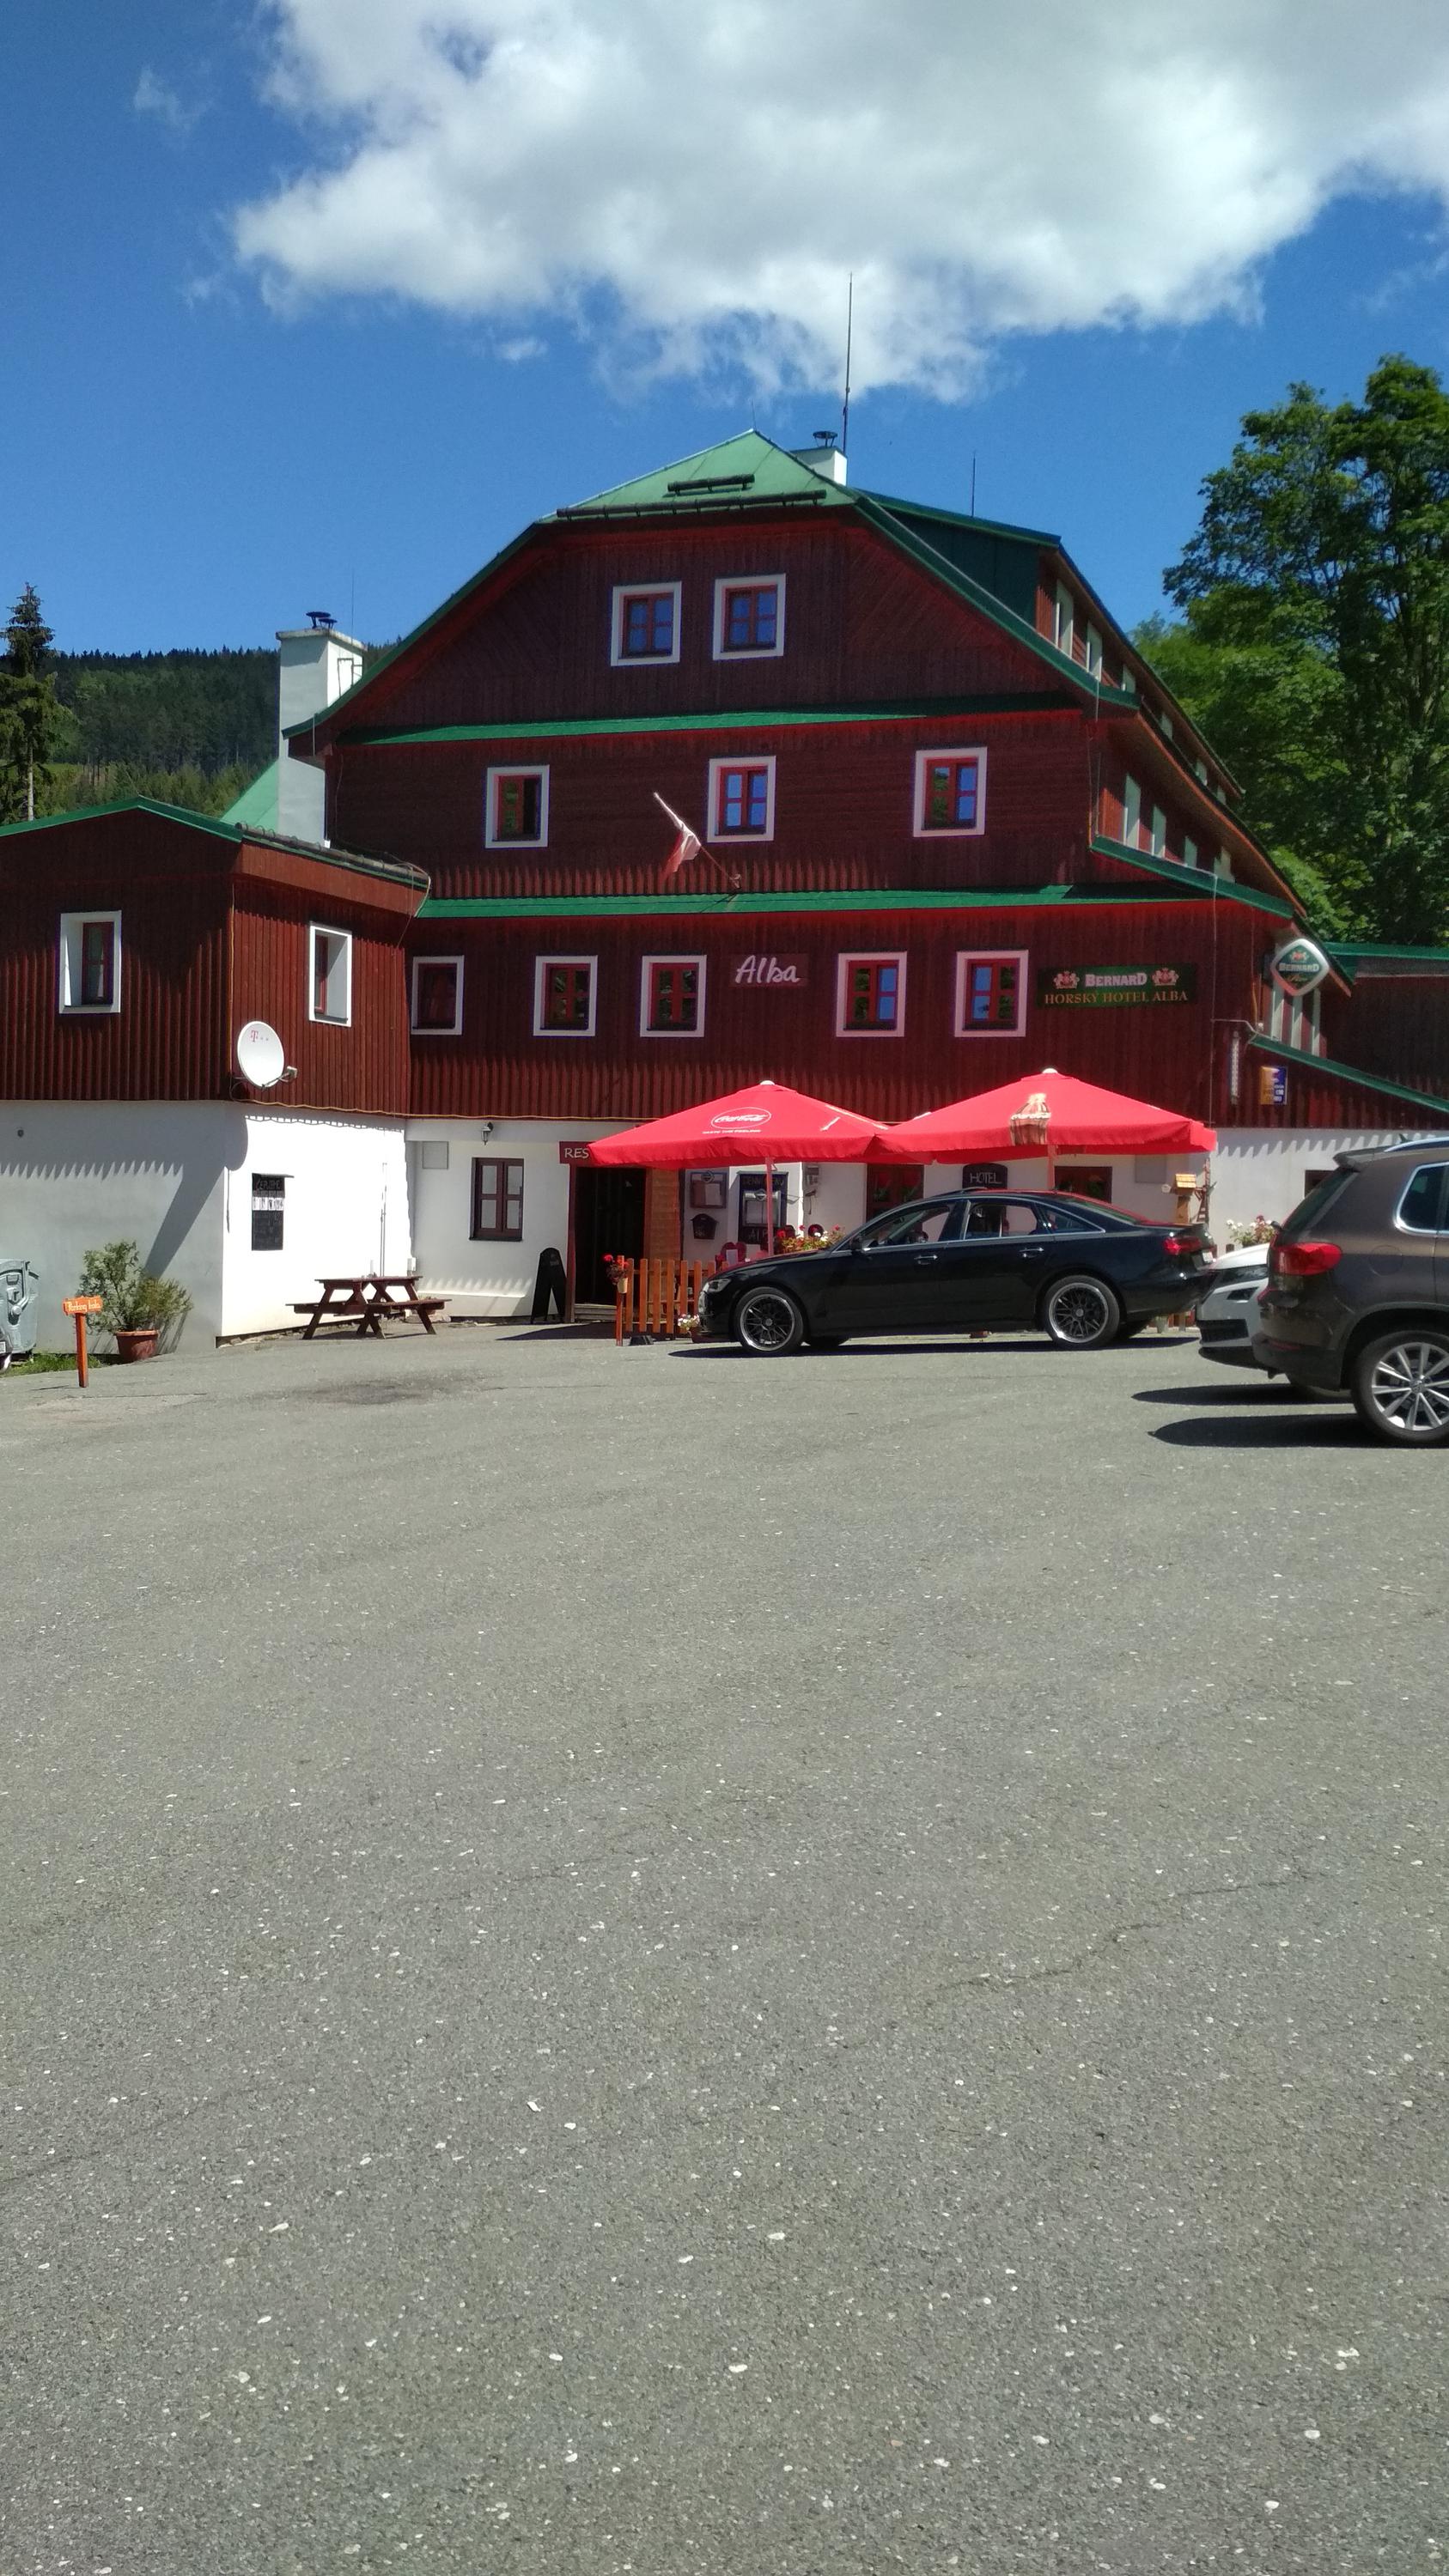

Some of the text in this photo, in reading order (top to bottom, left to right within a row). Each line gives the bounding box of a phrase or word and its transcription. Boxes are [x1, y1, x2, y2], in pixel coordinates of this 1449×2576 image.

[735, 955, 801, 984] Alba
[1085, 972, 1148, 987] BERNARD
[1103, 991, 1149, 1003] HOTEL
[1153, 990, 1189, 1002] ALBA
[970, 1171, 1003, 1184] HOTEL
